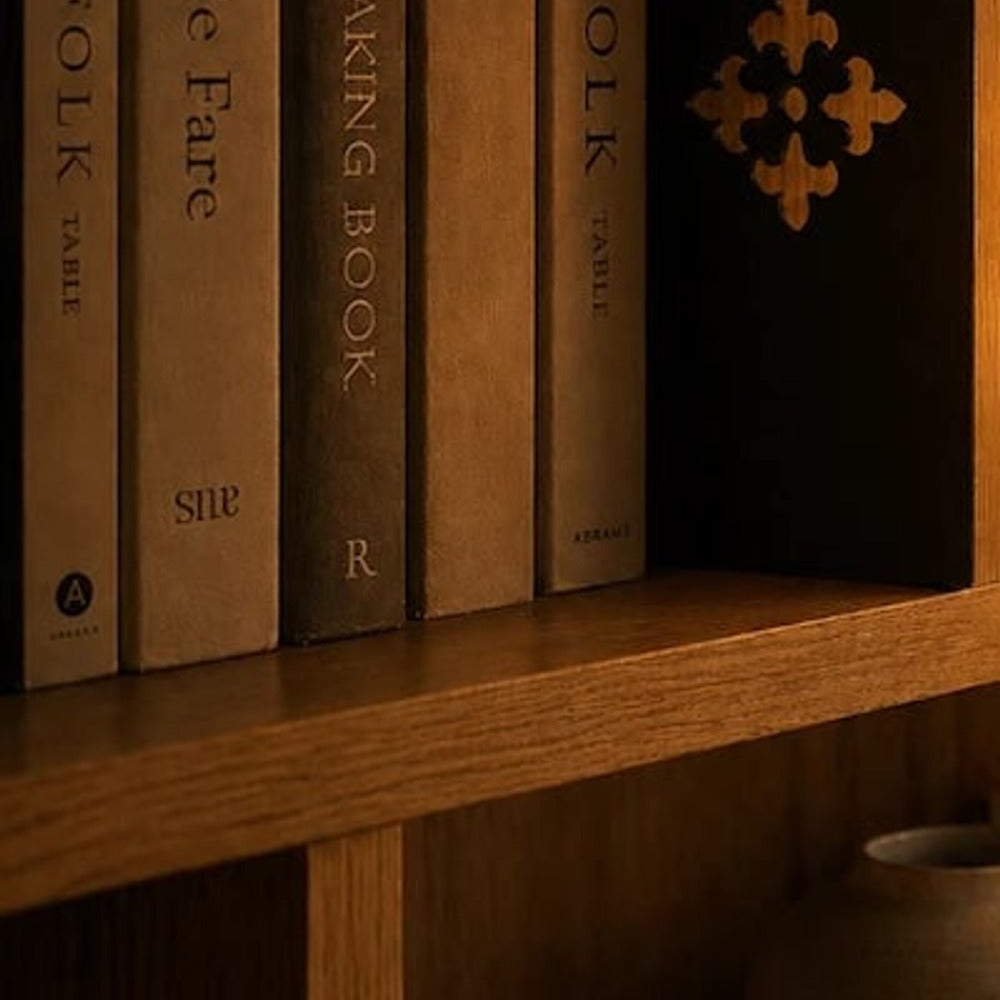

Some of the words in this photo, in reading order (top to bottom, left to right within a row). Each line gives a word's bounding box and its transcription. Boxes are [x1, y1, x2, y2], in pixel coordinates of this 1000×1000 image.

[185, 69, 232, 221] Fare
[61, 211, 82, 317] TABLE
[342, 202, 377, 393] BOOK
[591, 209, 610, 319] TABLE
[345, 538, 378, 579] R
